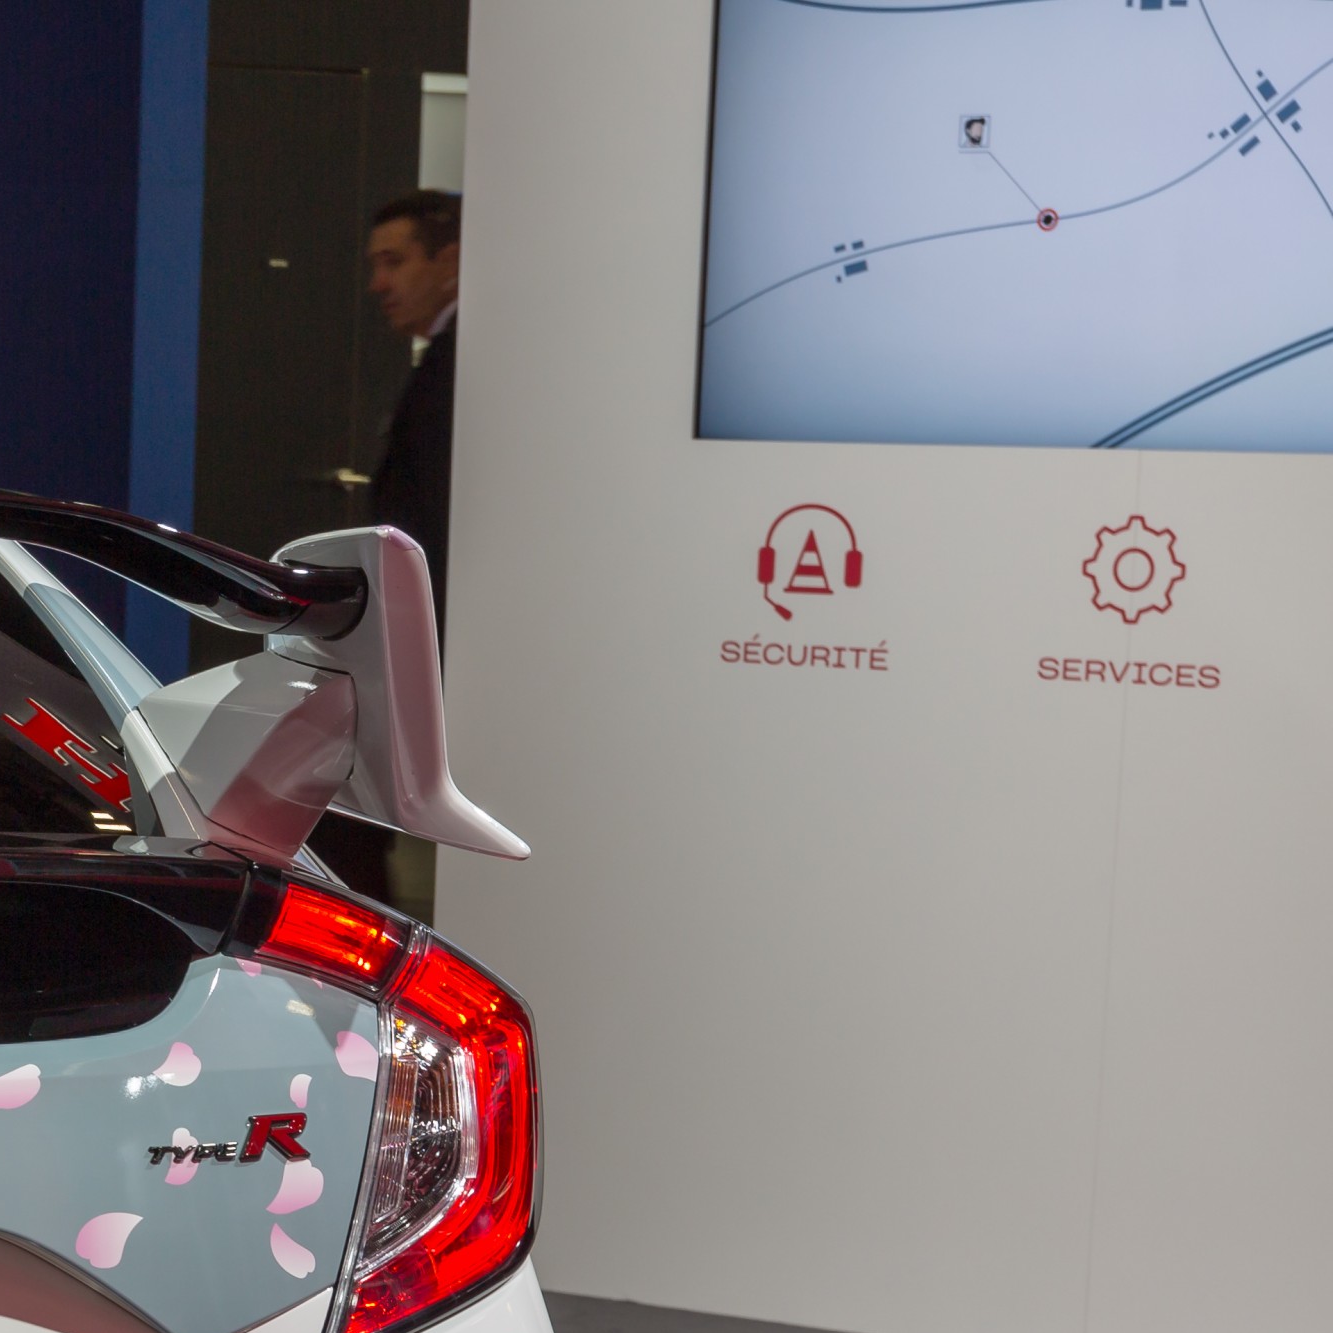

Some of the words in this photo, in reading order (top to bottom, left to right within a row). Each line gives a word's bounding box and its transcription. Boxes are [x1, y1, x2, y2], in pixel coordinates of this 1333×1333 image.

[720, 633, 889, 671] SÉCURITÉ
[1037, 657, 1221, 689] SERVICES
[148, 1142, 238, 1165] TYPE
[239, 1112, 311, 1163] R
